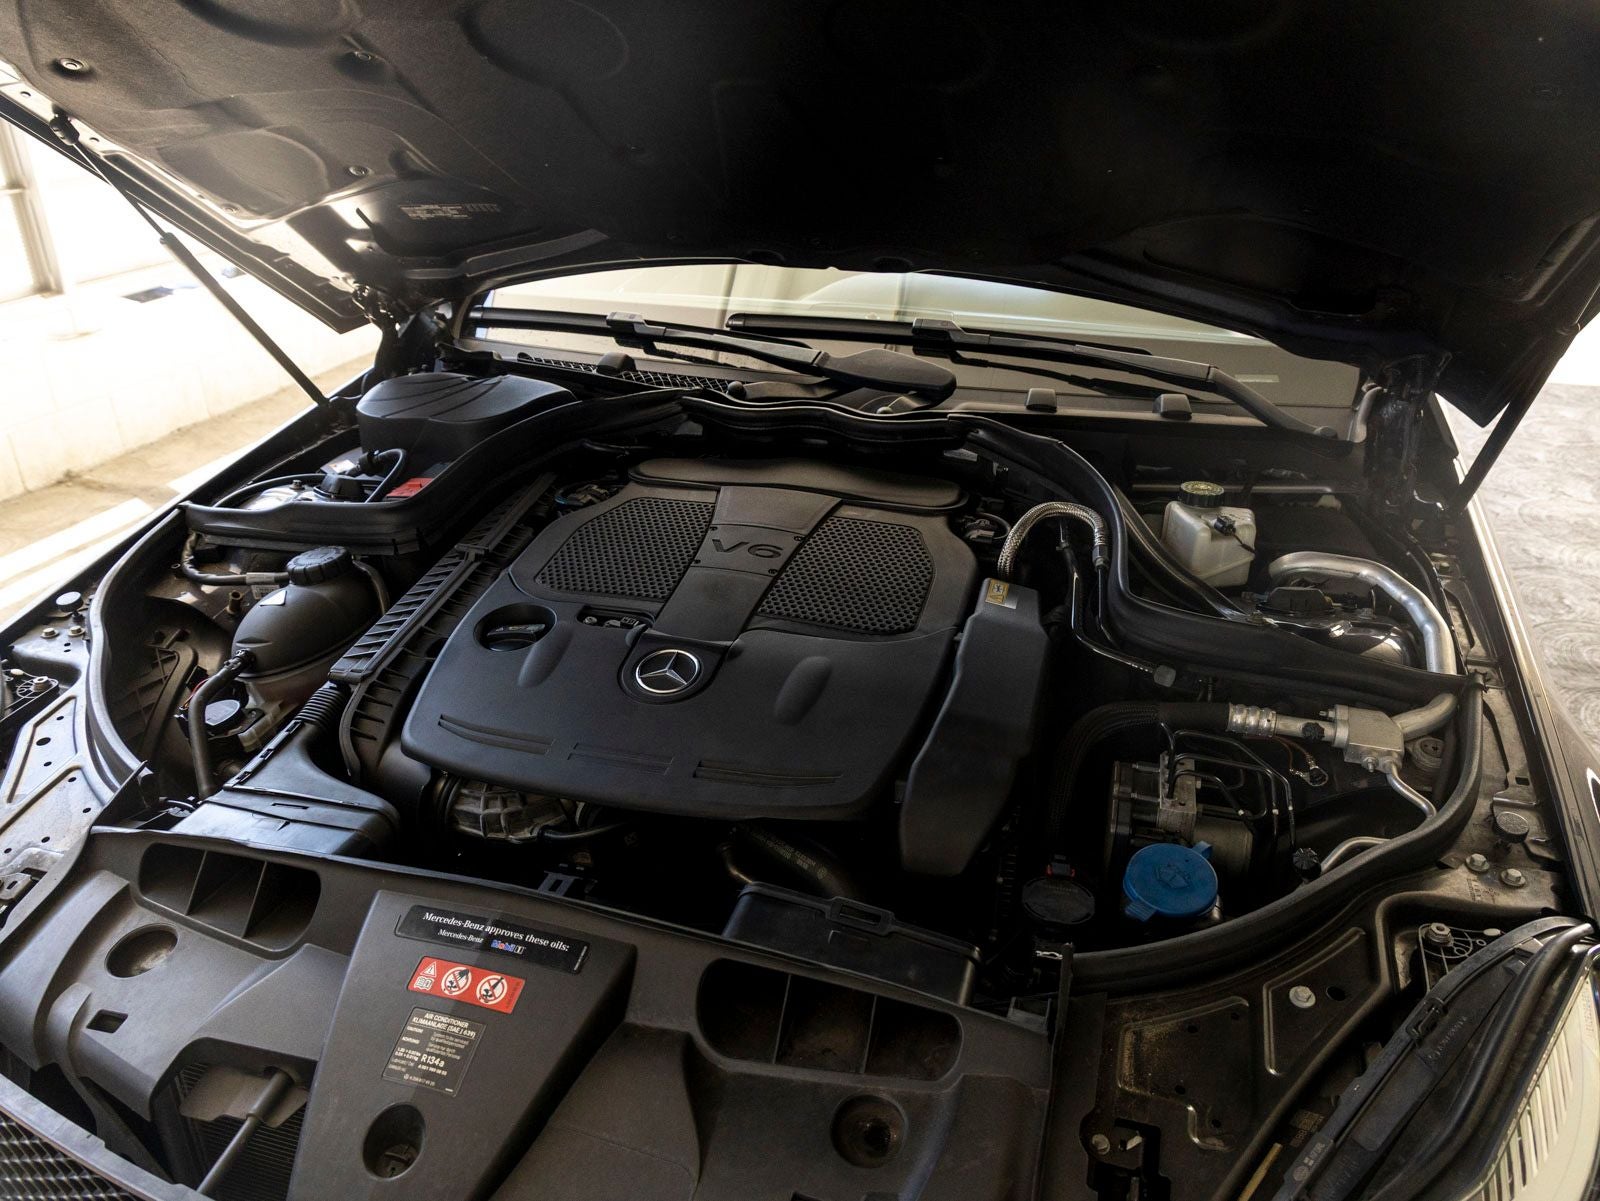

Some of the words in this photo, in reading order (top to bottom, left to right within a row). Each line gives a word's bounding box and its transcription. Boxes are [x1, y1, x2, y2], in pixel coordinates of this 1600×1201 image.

[712, 539, 784, 559] V6
[423, 912, 484, 931] Mercedes-Benz
[485, 925, 524, 941] approves
[525, 934, 550, 947] these
[550, 940, 570, 952] oils:
[438, 929, 484, 944] Mercedes-Benz
[420, 1053, 446, 1067] R134a
